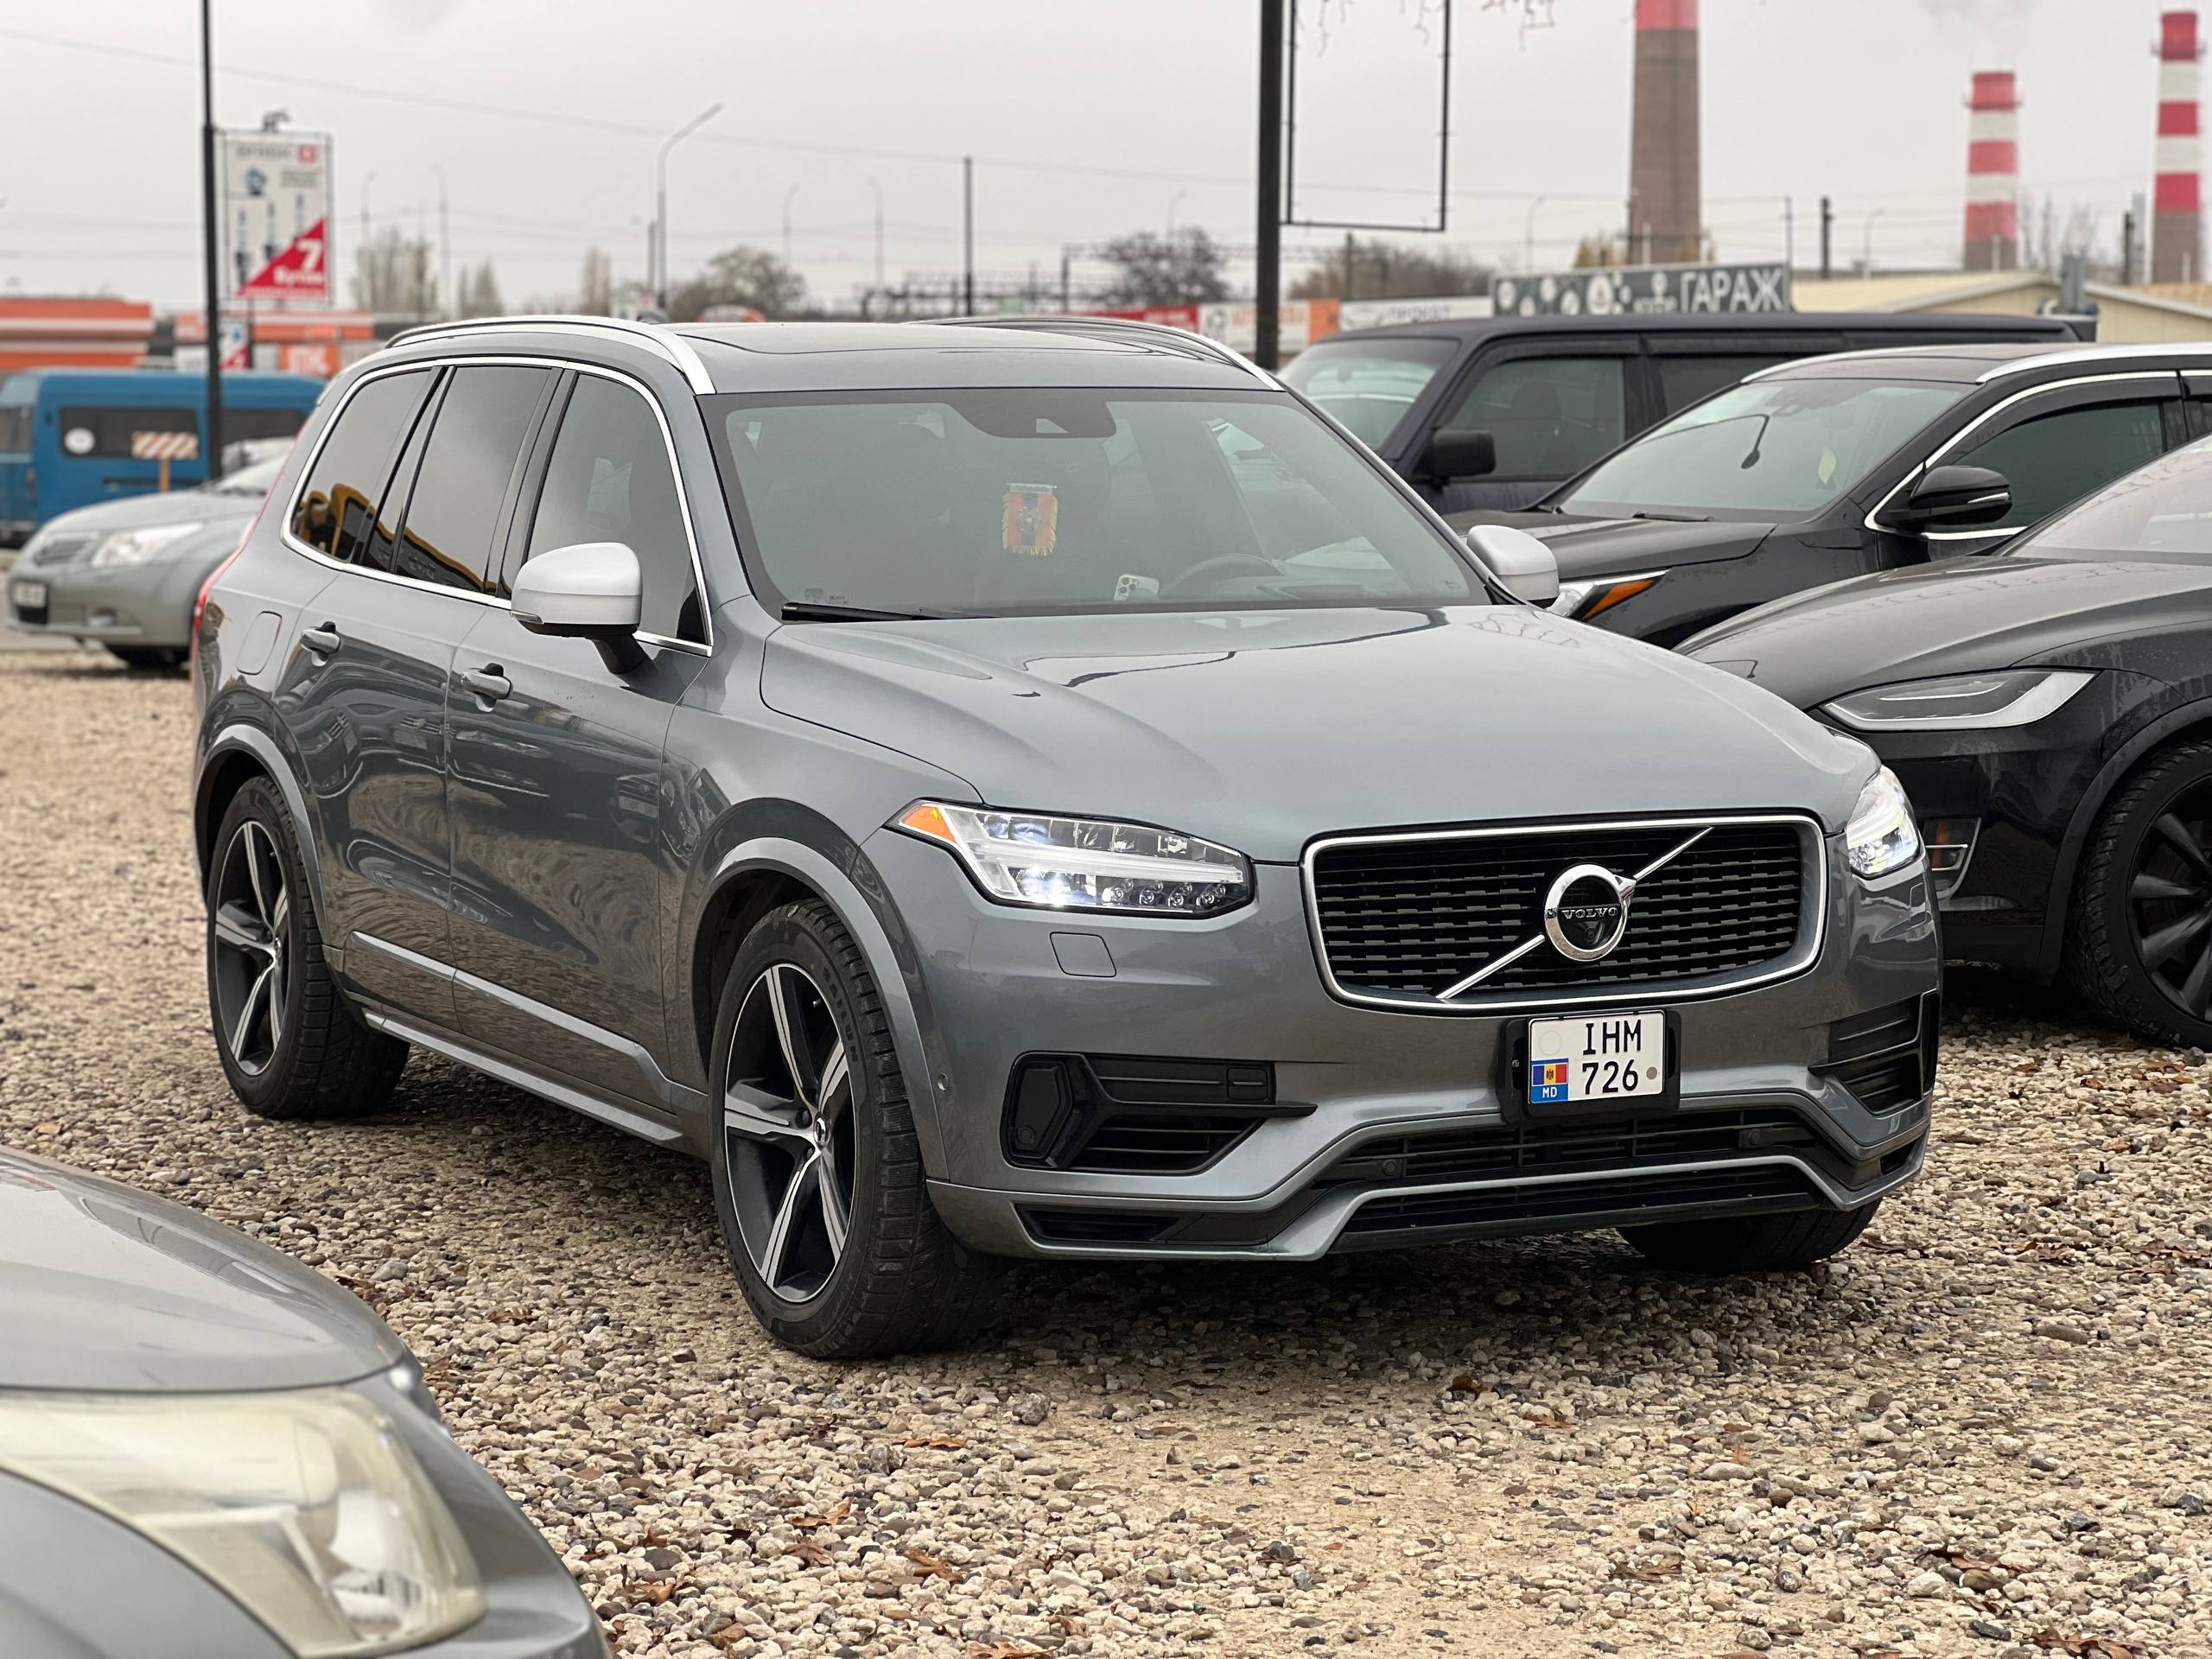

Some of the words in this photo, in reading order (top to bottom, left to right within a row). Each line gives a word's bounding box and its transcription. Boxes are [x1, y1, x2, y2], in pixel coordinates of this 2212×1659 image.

[1680, 266, 1783, 312] ГАРАЖ
[1561, 907, 1618, 919] VOLVO
[1582, 1019, 1642, 1055] IHM
[1541, 1086, 1558, 1098] MD
[1582, 1058, 1639, 1095] 726
